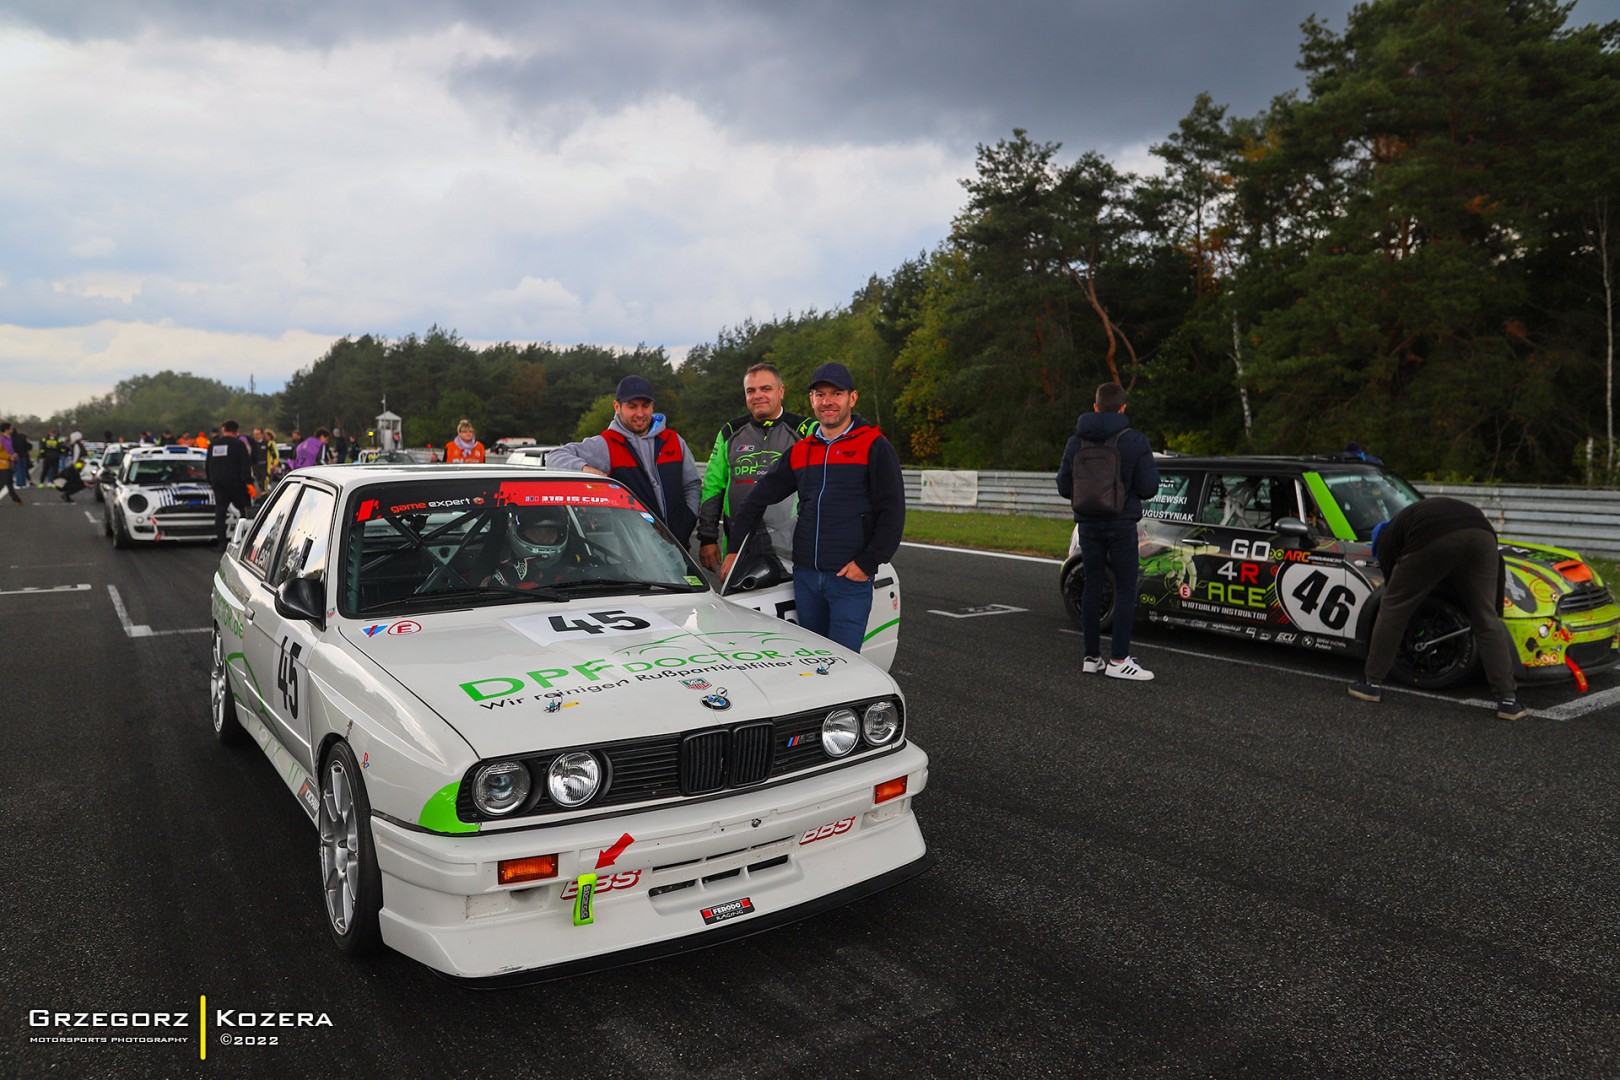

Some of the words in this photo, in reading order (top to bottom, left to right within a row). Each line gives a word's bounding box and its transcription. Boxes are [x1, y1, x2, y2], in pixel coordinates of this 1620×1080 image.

[734, 465, 758, 476] DPF
[389, 501, 427, 513] game
[428, 497, 471, 508] expert
[1146, 494, 1188, 505] NIEWSKI
[1230, 538, 1271, 562] GO
[1283, 549, 1311, 563] ARC
[1208, 581, 1267, 608] ACE
[1291, 569, 1357, 631] 46
[548, 610, 651, 635] 45
[278, 635, 303, 720] 45
[458, 659, 614, 702] DPF
[479, 697, 525, 710] Wir
[533, 678, 630, 701] reinigen
[634, 659, 793, 682] Rußpartikelfilter
[799, 816, 856, 845] BBS
[712, 902, 742, 915] FERODO
[715, 909, 744, 921] RACING
